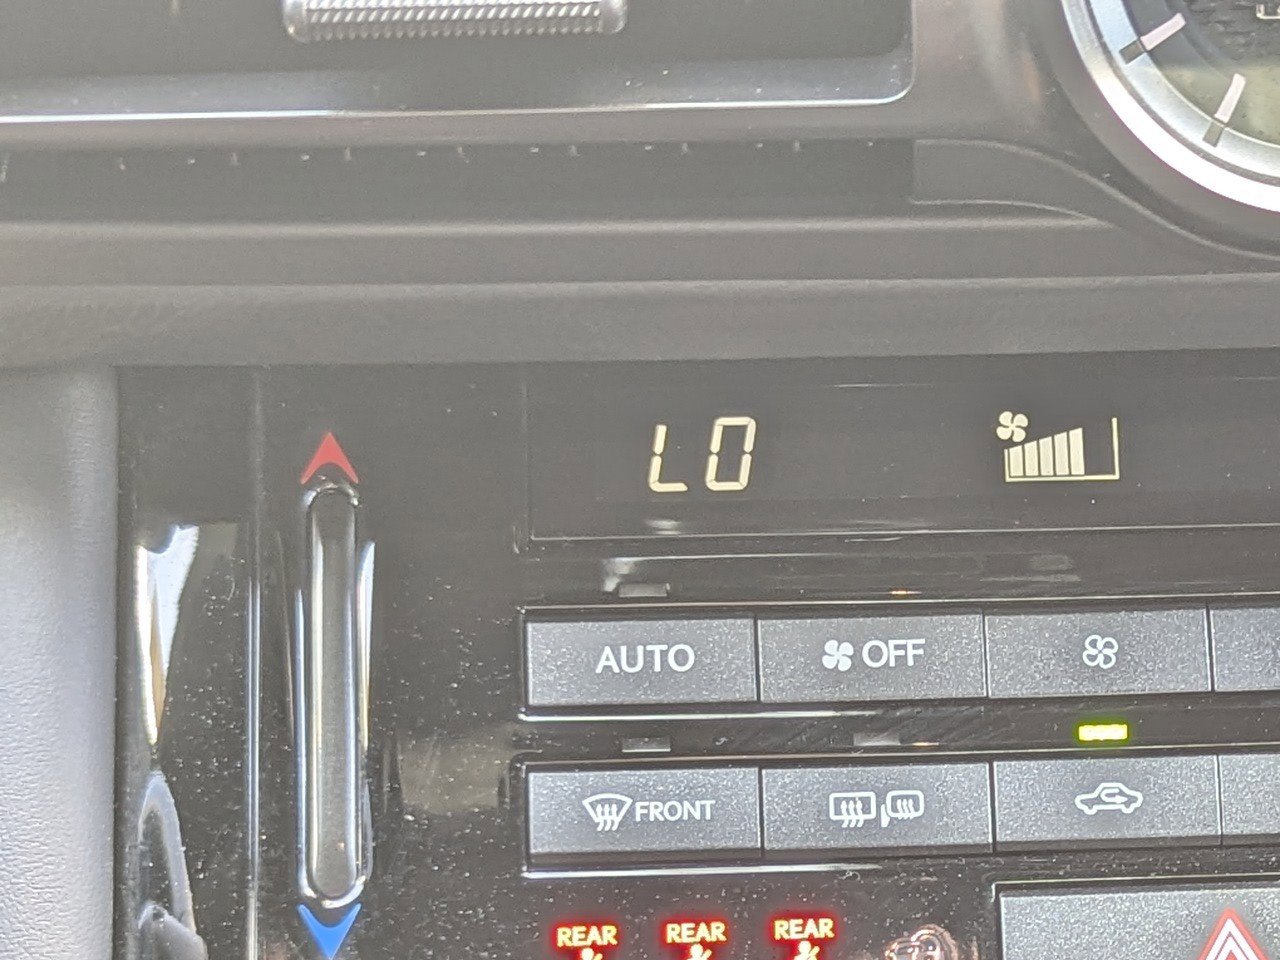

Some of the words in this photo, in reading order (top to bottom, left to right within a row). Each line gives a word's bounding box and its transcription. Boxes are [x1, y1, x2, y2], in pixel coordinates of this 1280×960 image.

[595, 644, 696, 675] AUTO
[861, 638, 926, 669] OFF
[634, 799, 716, 823] FRONT
[556, 924, 618, 947] REAR
[665, 922, 726, 944] REAR
[773, 918, 835, 940] REAR
